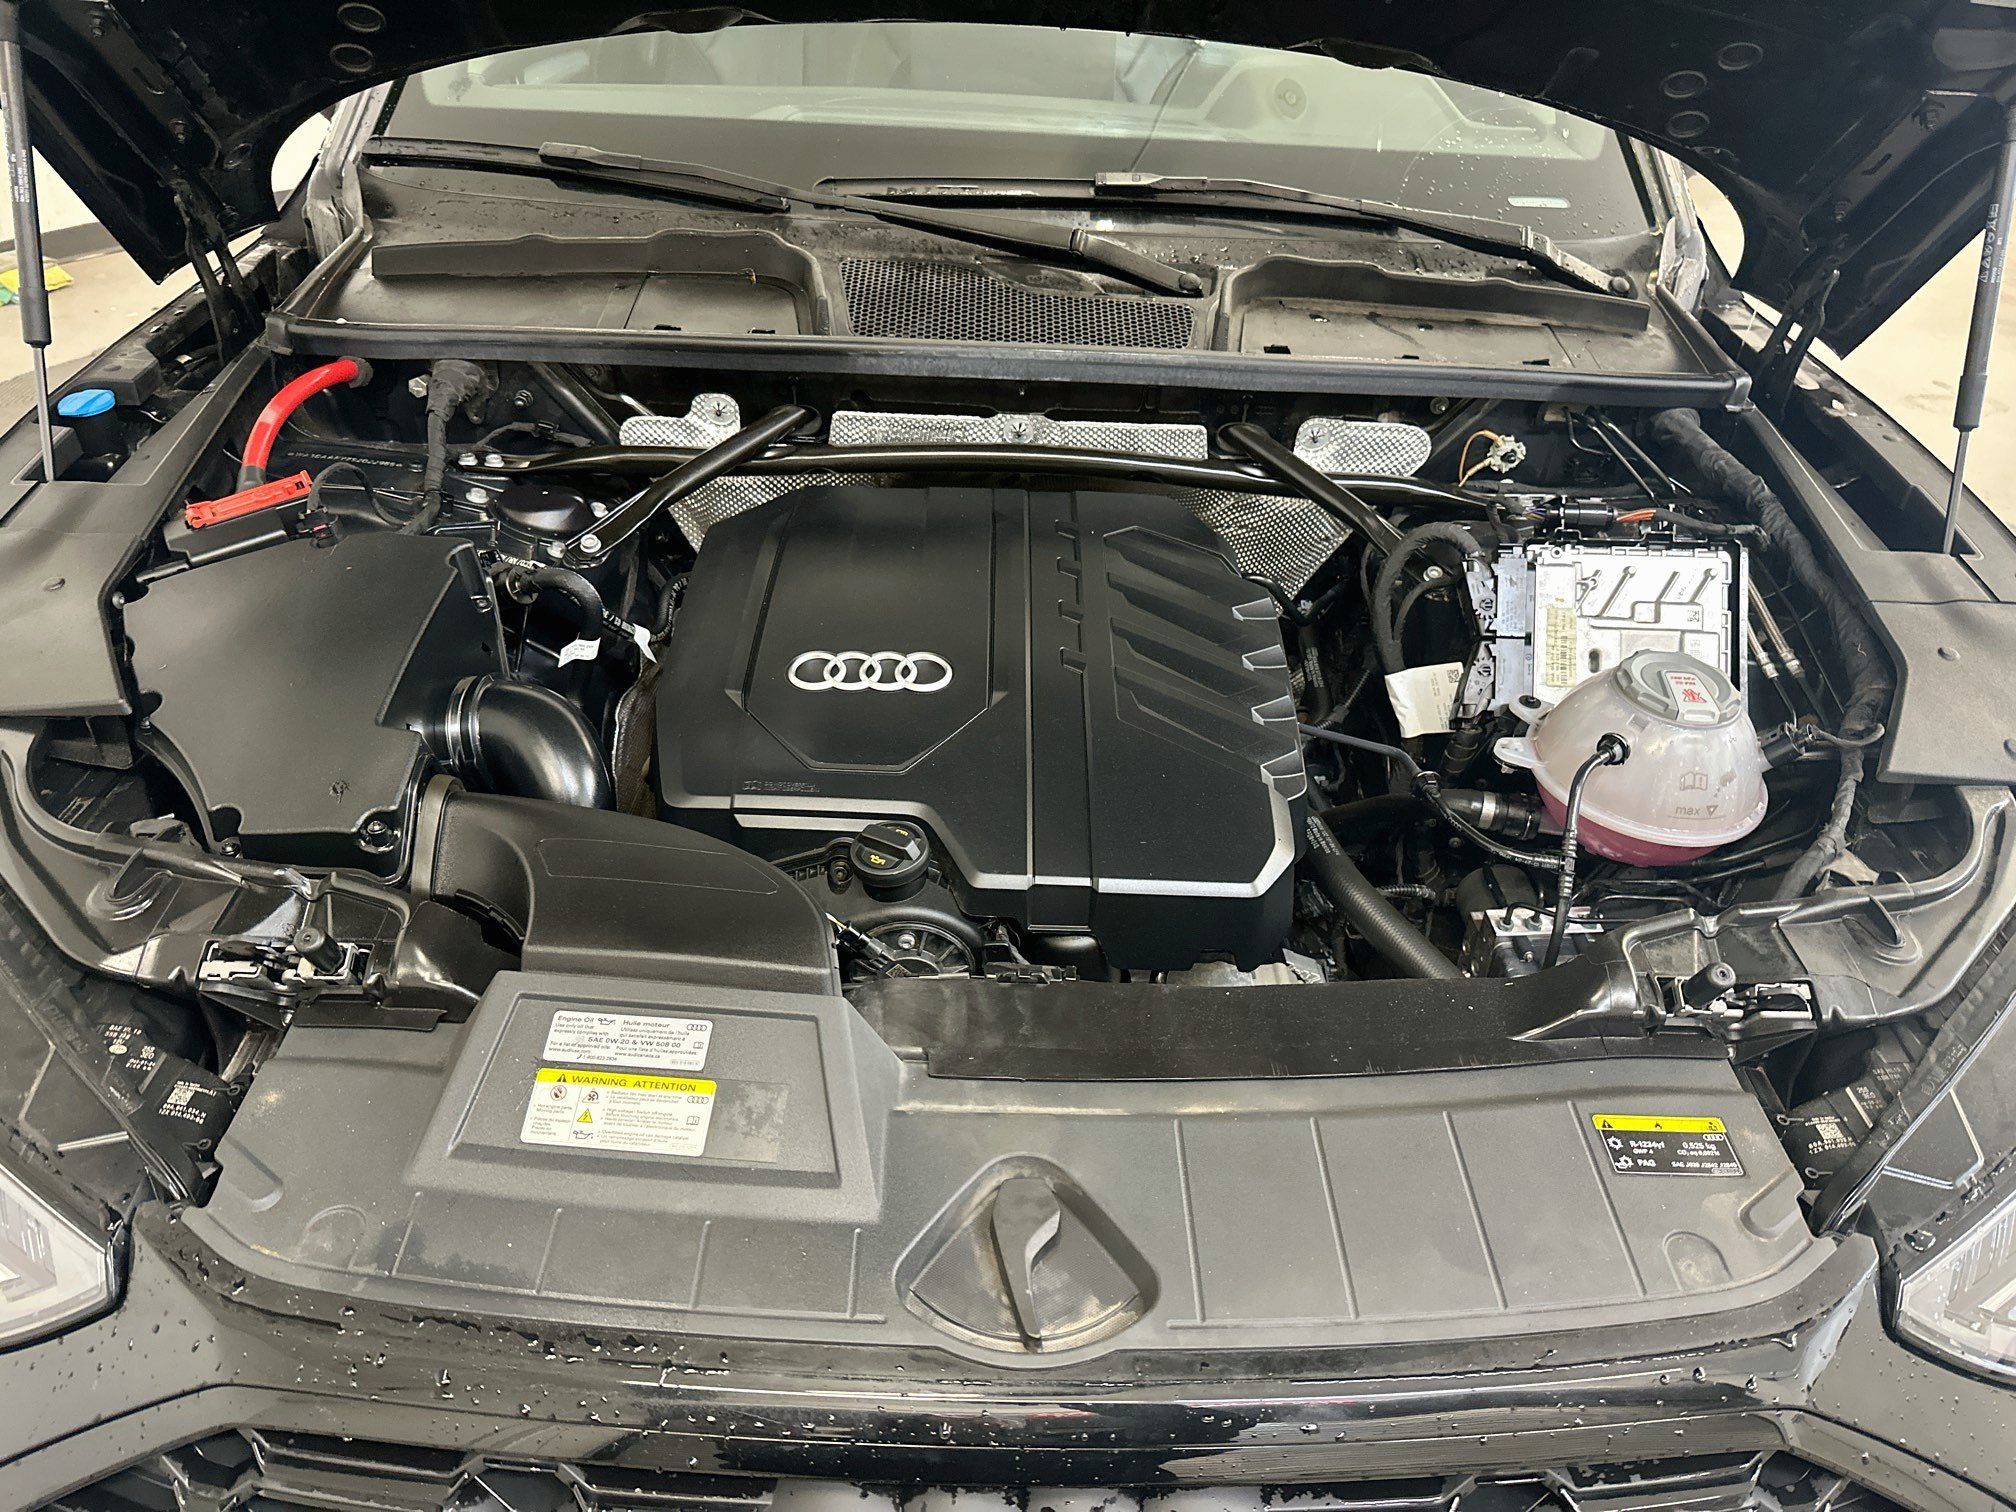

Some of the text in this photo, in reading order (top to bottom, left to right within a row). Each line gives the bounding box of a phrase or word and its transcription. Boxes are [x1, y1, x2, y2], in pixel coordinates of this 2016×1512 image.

[1675, 805, 1701, 816] max
[571, 1075, 696, 1092] WARNING ATTENTION
[1683, 1141, 1704, 1149] 0,525
[1638, 1158, 1656, 1166] PAG
